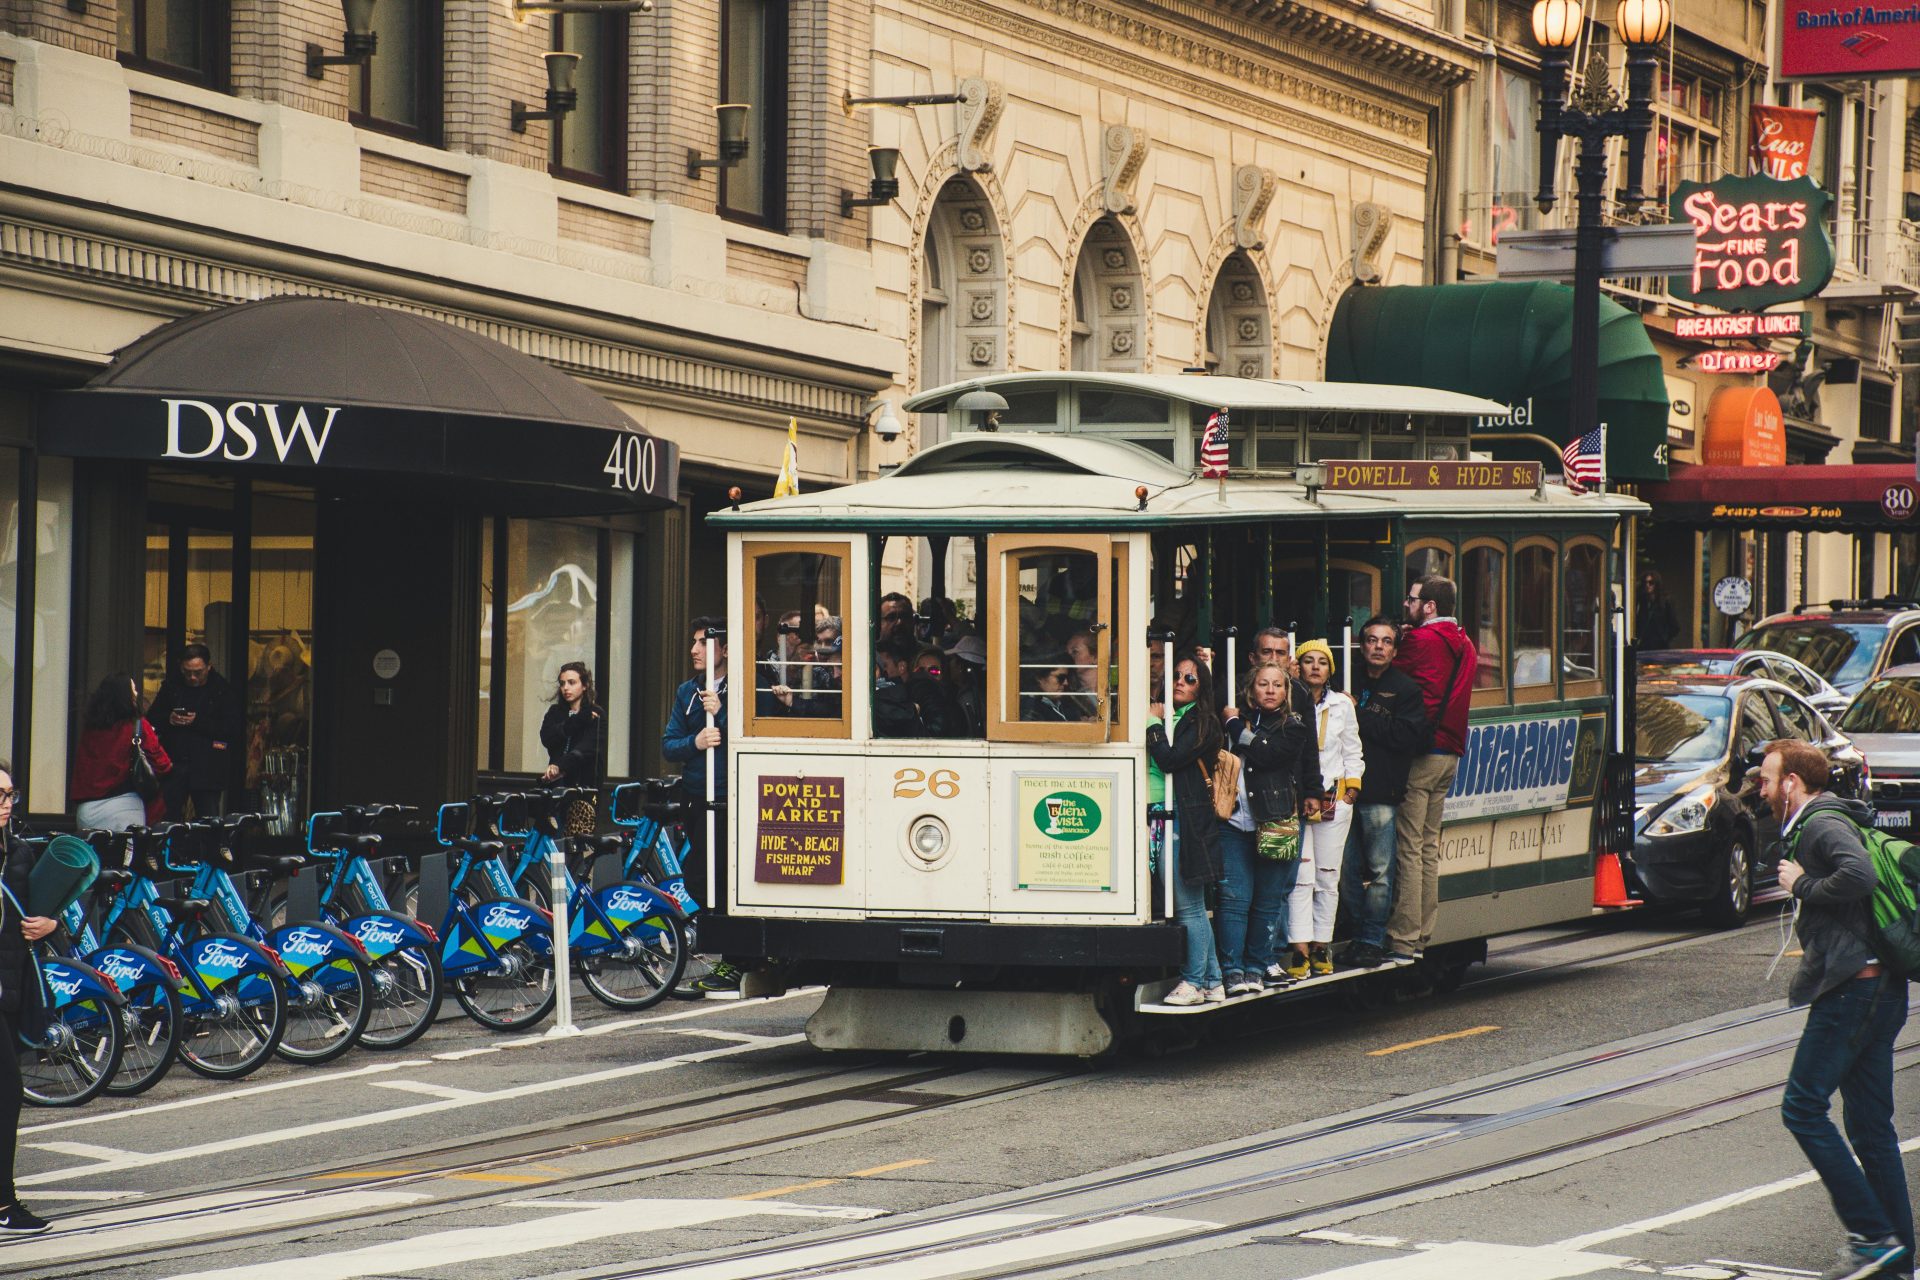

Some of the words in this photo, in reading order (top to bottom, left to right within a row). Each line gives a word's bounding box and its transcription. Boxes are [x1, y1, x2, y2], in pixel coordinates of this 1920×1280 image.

[1797, 8, 1841, 29] Bank
[1843, 6, 1862, 26] of
[1863, 4, 1920, 24] Ameri
[1751, 117, 1805, 156] Lux
[1684, 191, 1807, 237] Sears
[1727, 238, 1768, 255] FINE
[1692, 238, 1802, 294] Food
[1676, 317, 1755, 336] BREAKFAST
[160, 398, 341, 464] DSW
[603, 434, 656, 494] 400
[1332, 466, 1412, 486] POWELL
[1428, 465, 1440, 486] &
[1456, 467, 1503, 486] HYDE
[1512, 467, 1534, 485] Sts.
[1885, 488, 1914, 509] 80
[1712, 504, 1758, 517] Sears
[1810, 505, 1842, 518] Food
[1446, 718, 1577, 798] nflatable
[763, 783, 840, 798] POWELL
[894, 768, 960, 799] 26
[783, 798, 821, 808] AND
[761, 808, 842, 823] MARKET
[761, 835, 788, 850] HYDE
[804, 836, 839, 851] BEACH
[766, 853, 832, 865] FISHERMANS
[781, 865, 815, 876] WHARF
[607, 889, 652, 912] Ford
[484, 906, 531, 930] Ford
[282, 931, 333, 955] Ford
[355, 920, 405, 944] Ford
[98, 954, 145, 980] Ford
[198, 943, 249, 968] Ford
